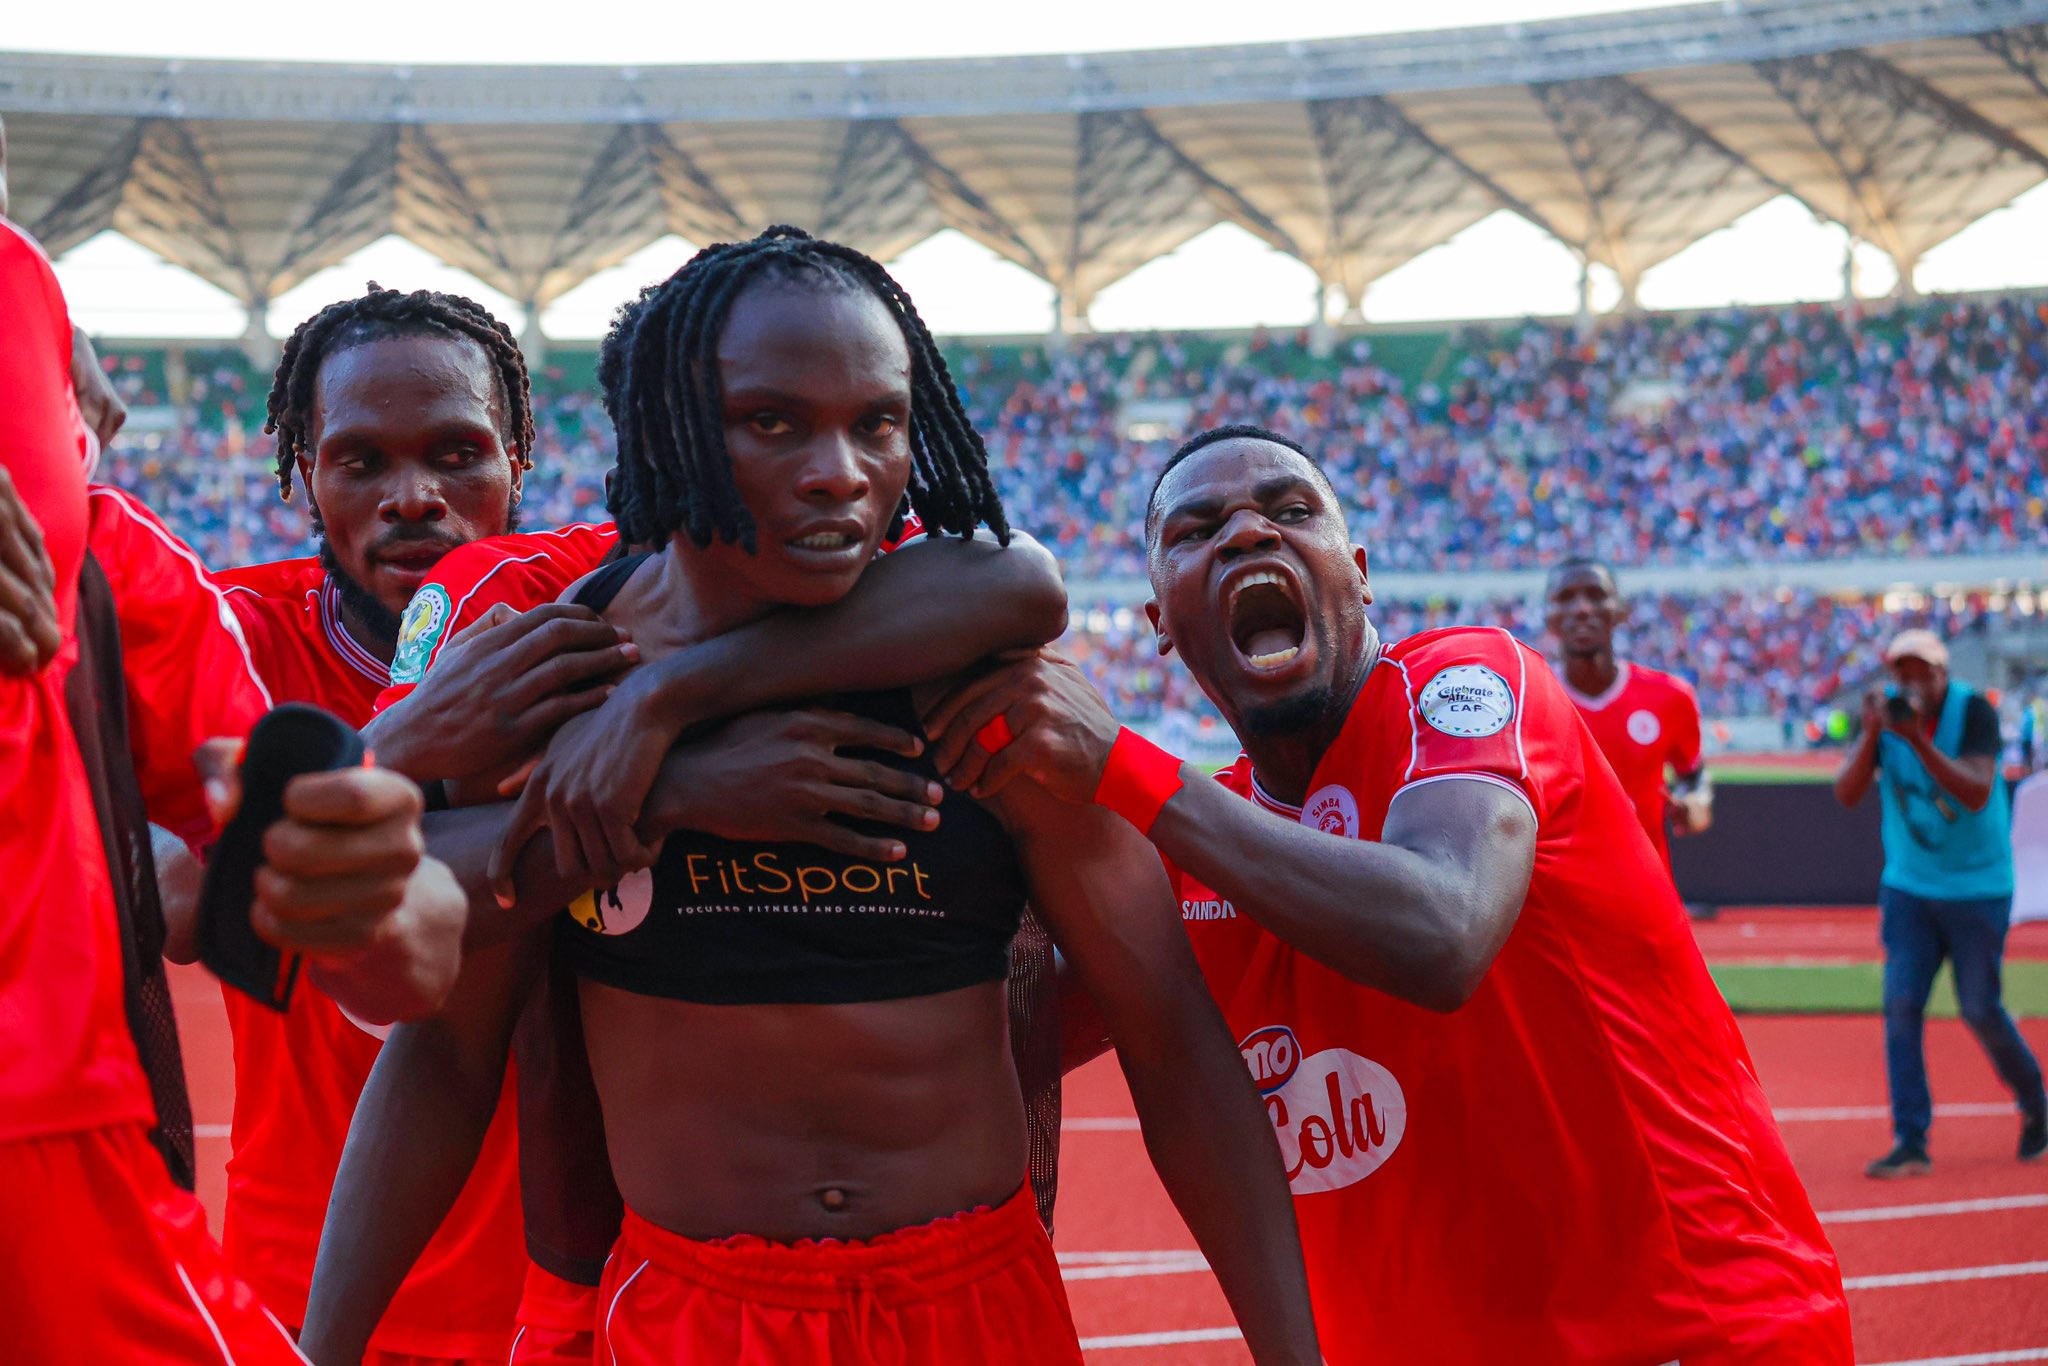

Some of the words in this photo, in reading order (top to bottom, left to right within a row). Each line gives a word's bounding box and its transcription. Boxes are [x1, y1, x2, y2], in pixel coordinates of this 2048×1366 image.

[1437, 685, 1493, 699] Celebrate
[1447, 691, 1482, 703] Africa
[1450, 704, 1482, 712] CAF
[1312, 797, 1340, 818] SIMBA
[686, 853, 931, 902] FitSport
[677, 905, 740, 915] FOCUSED
[748, 905, 808, 913] FITNESS
[815, 905, 842, 913] AND
[849, 905, 944, 917] CONDITIONING
